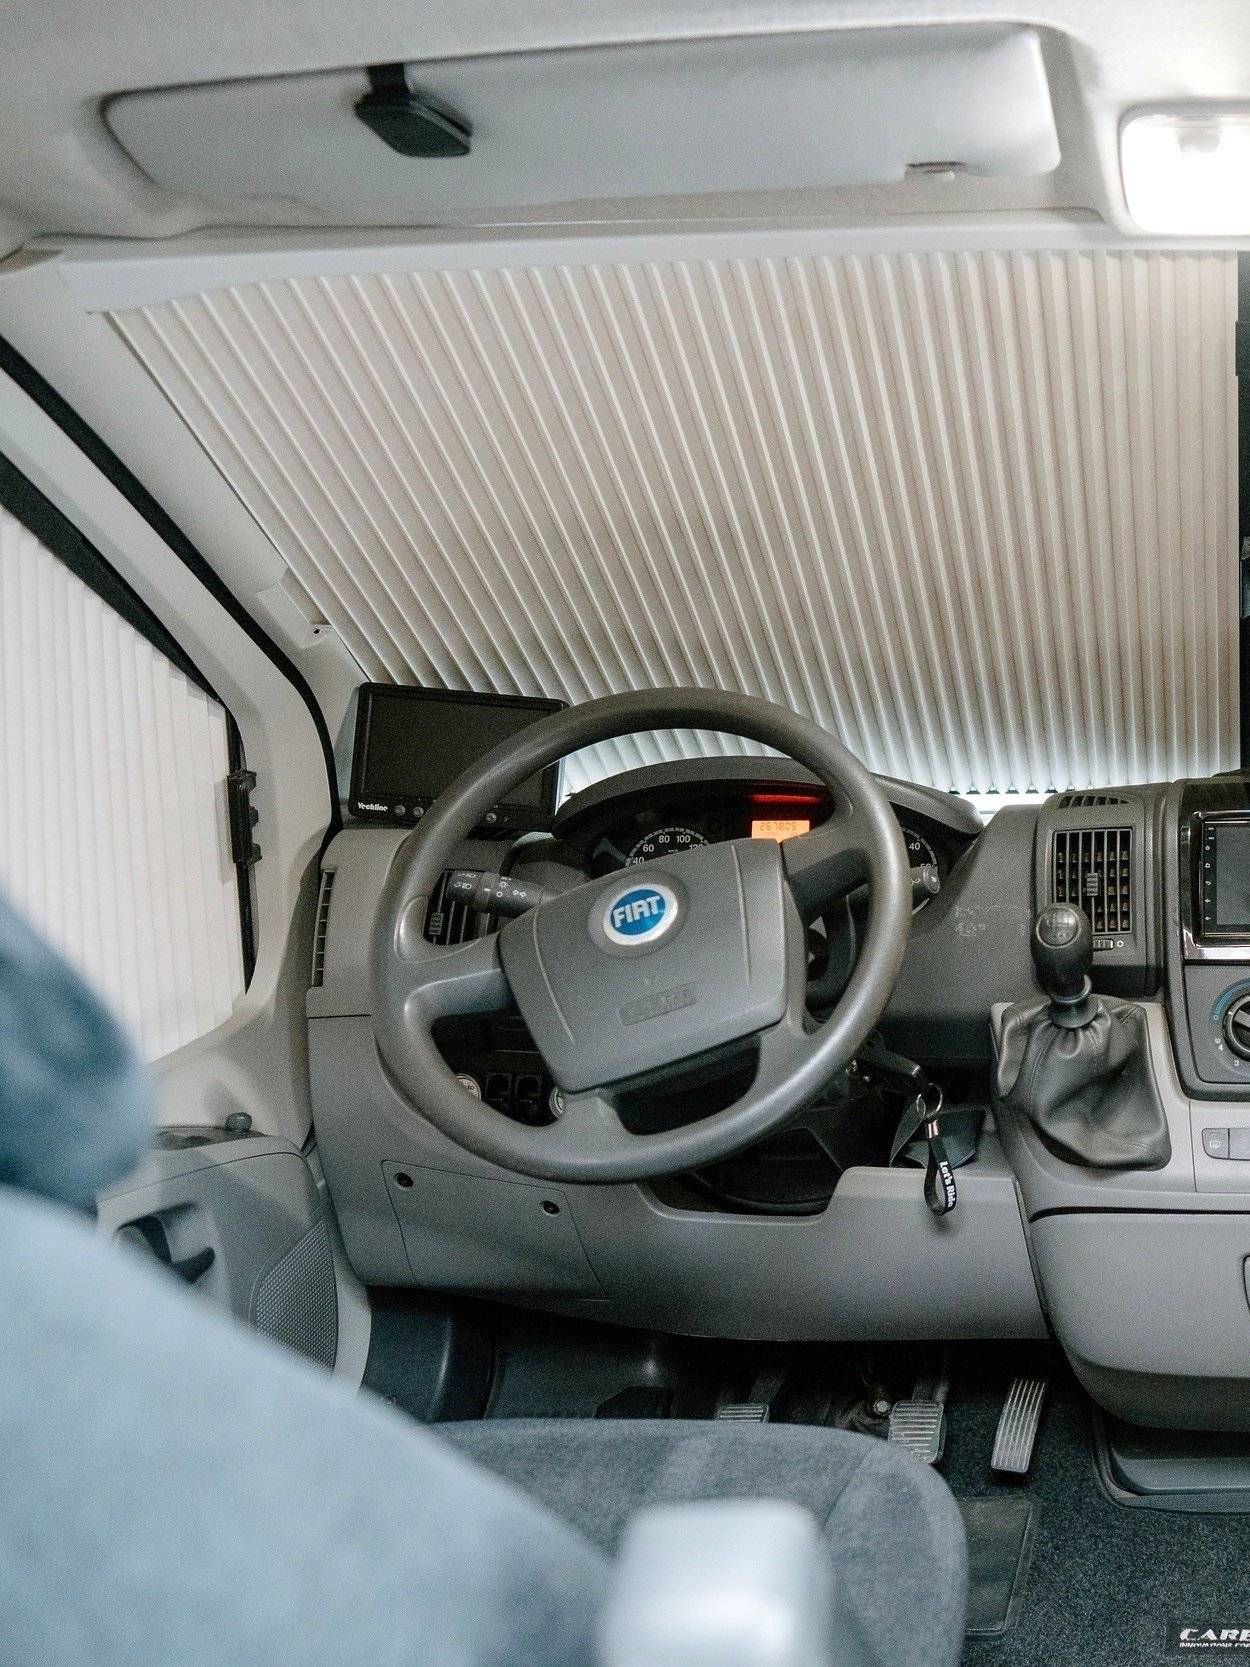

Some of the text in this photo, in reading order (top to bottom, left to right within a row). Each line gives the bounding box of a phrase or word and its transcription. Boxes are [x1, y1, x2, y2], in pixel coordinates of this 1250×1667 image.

[658, 835, 670, 843] 80
[676, 835, 691, 843] 100
[642, 844, 655, 853] 60
[909, 842, 920, 850] 40
[612, 895, 661, 928] FIAT
